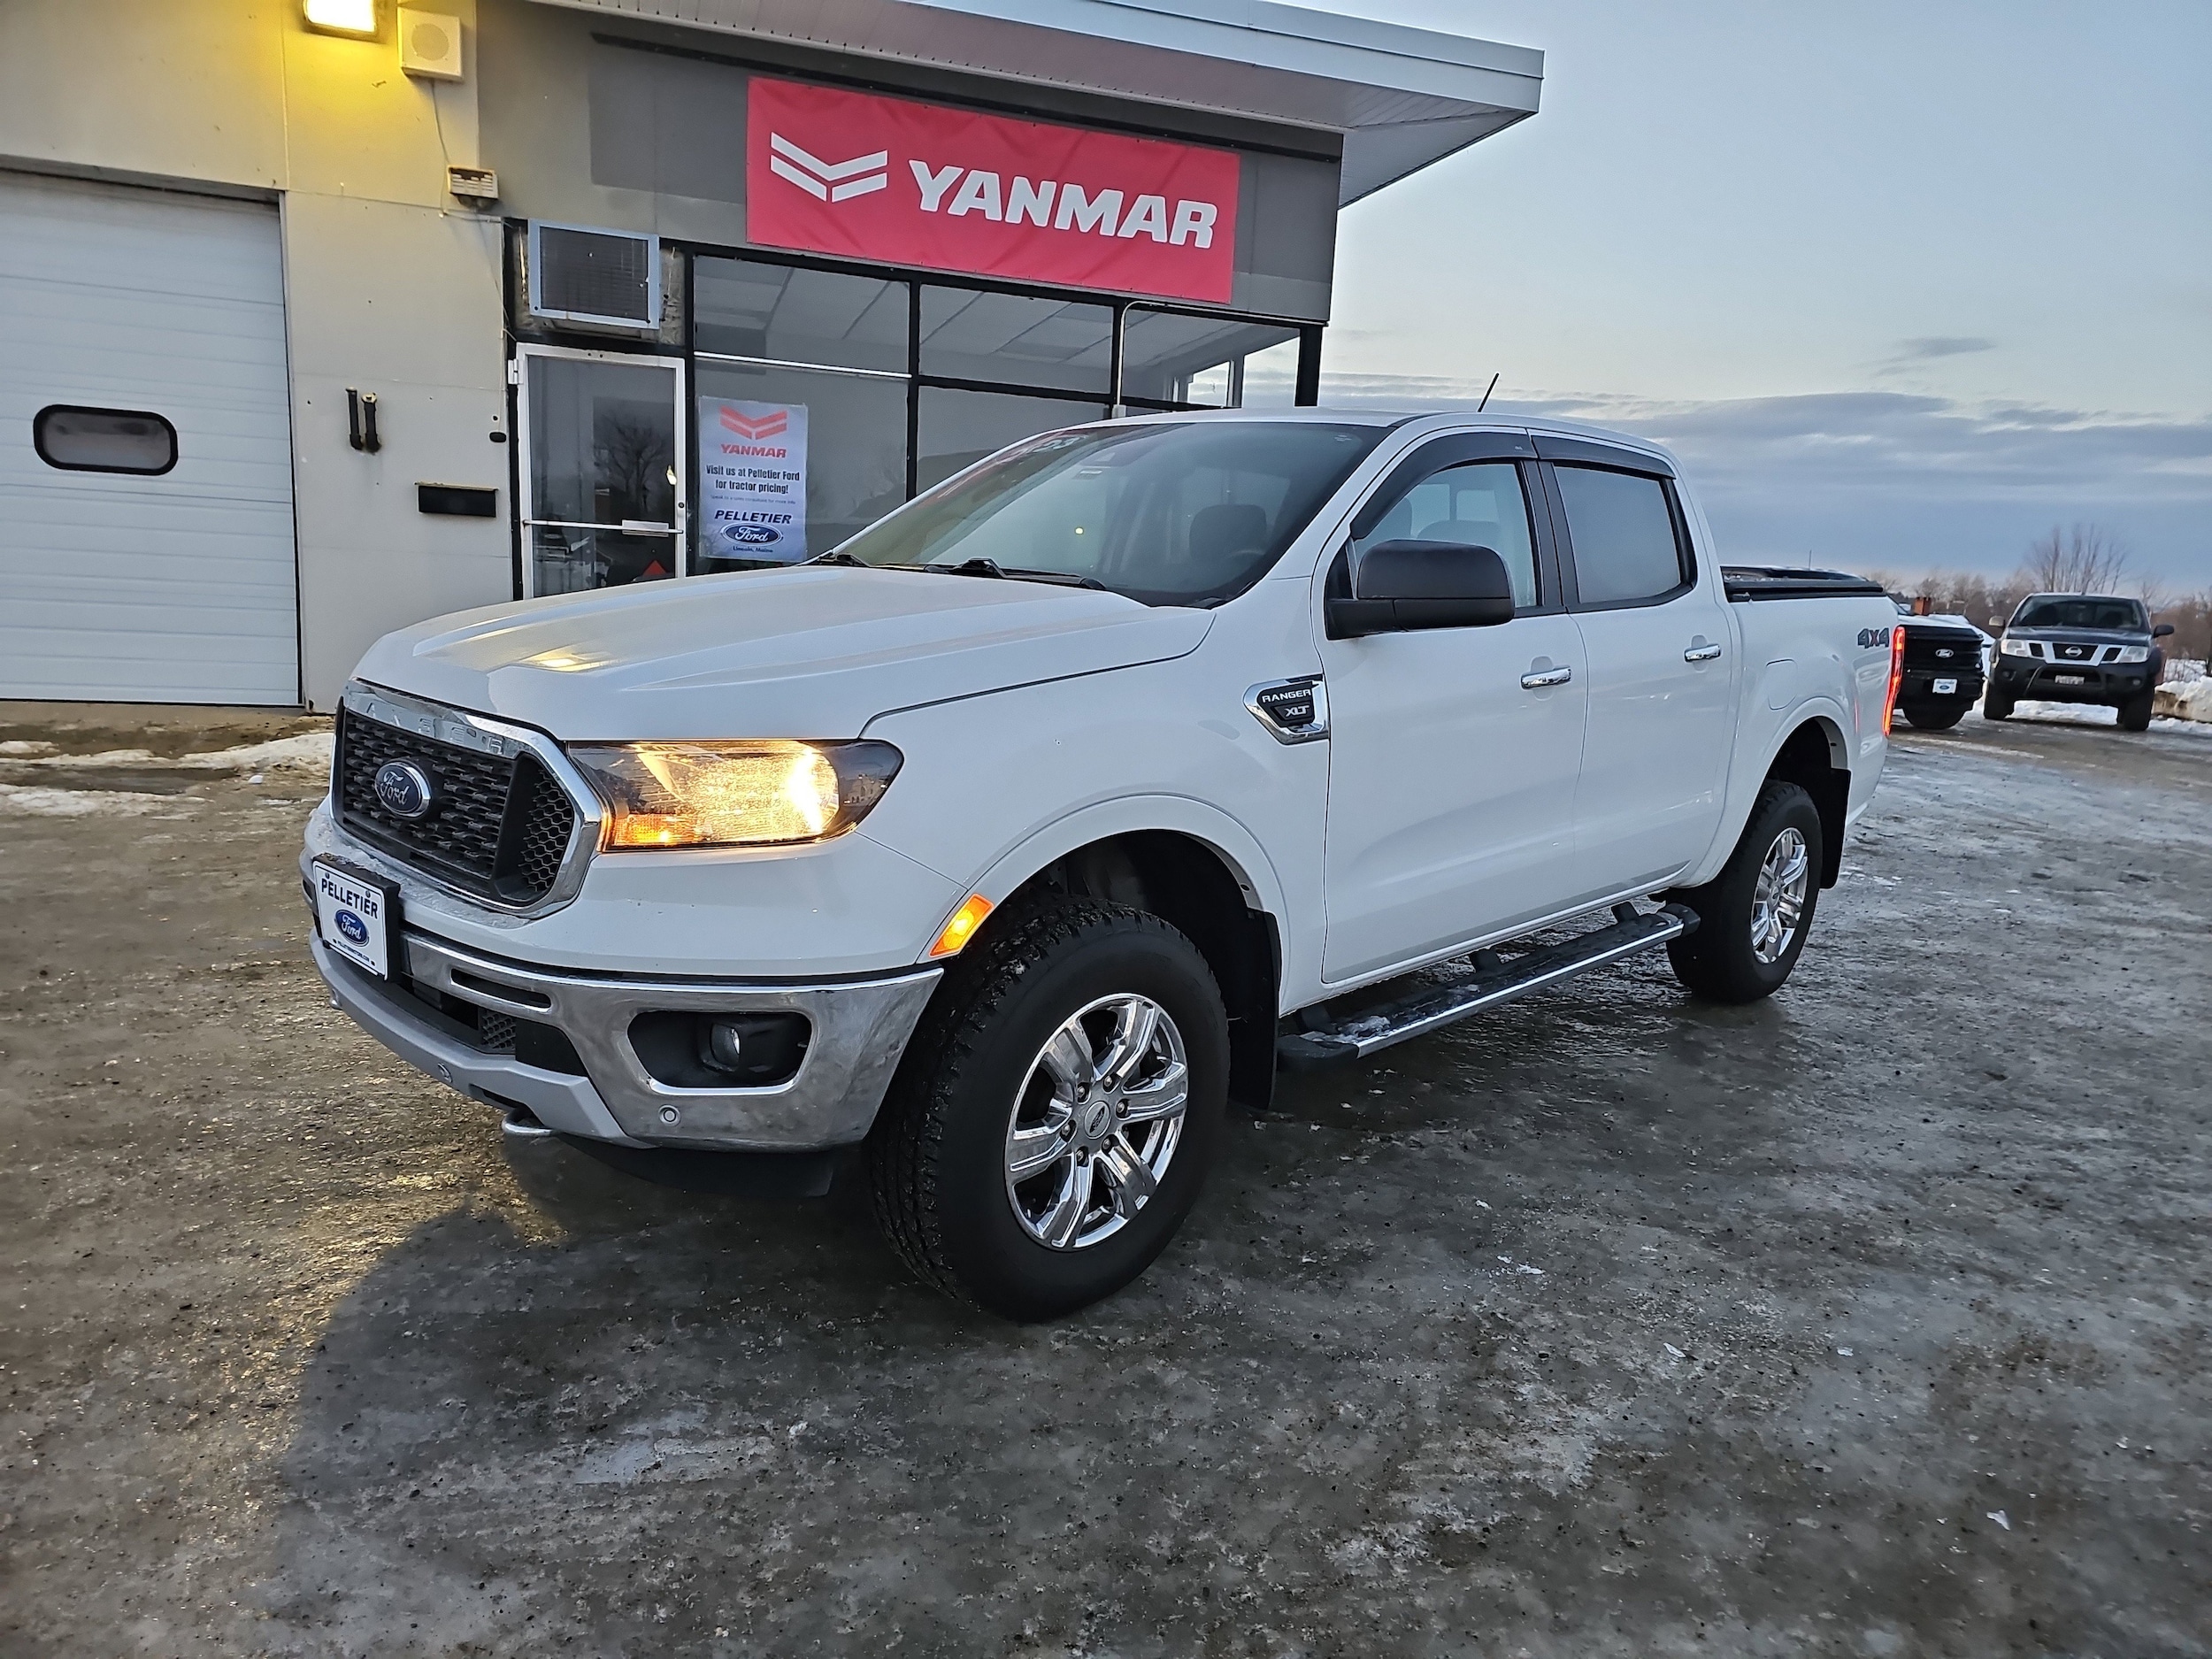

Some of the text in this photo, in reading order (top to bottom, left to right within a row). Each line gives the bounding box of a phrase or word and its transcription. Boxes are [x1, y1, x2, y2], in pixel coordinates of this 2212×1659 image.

[908, 158, 1218, 250] YANMAR
[720, 443, 787, 458] YANMAR
[706, 465, 800, 480] Visit us at Pelletier Ford
[715, 479, 788, 495] for tractor pricing!
[714, 510, 792, 524] PELLETIER
[734, 526, 769, 541] Ford
[1262, 689, 1311, 703] RANGER
[1284, 705, 1310, 718] XLT
[380, 771, 410, 804] Ford
[321, 878, 378, 919] PELLETIER
[341, 914, 362, 940] Ford
